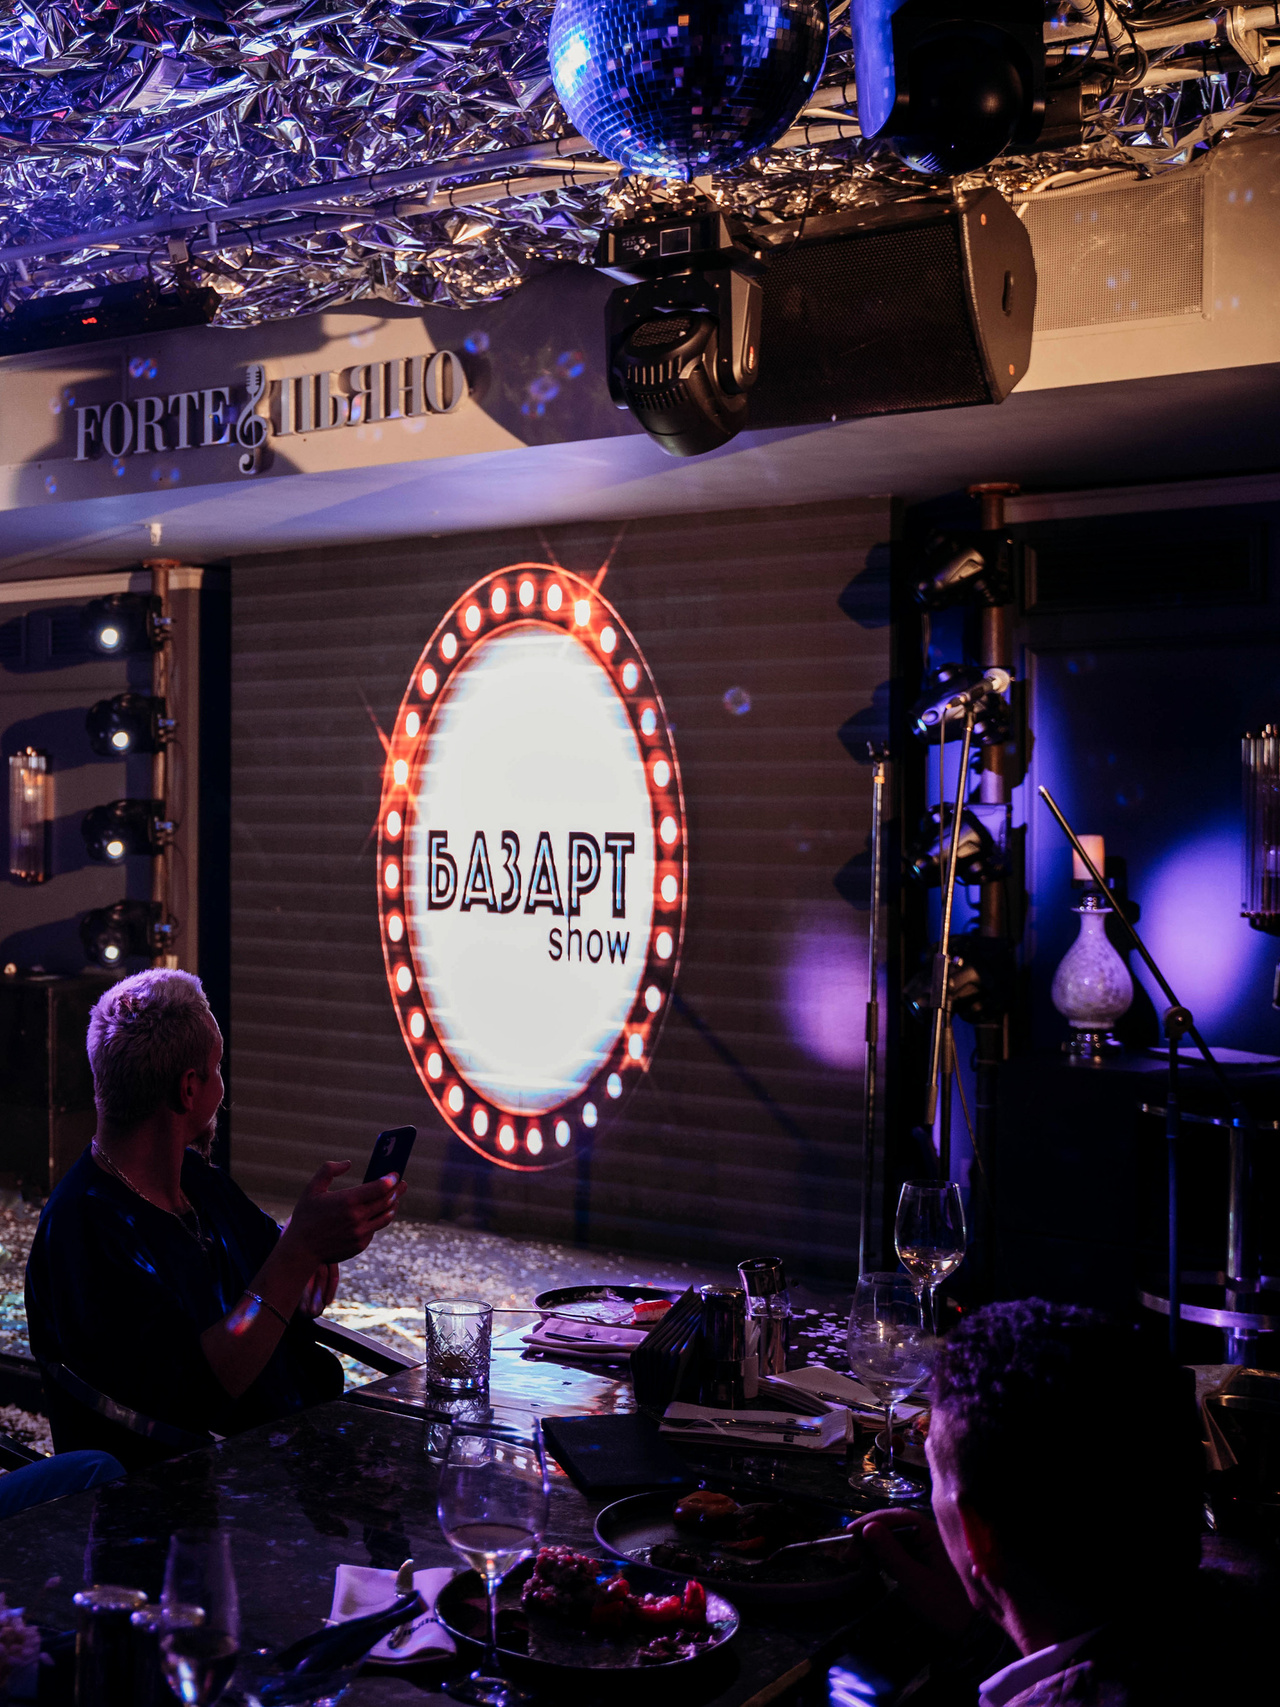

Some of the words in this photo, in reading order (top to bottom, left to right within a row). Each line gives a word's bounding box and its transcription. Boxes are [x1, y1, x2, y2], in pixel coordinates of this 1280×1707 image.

[73, 386, 231, 461] FORTE
[270, 350, 464, 436] ПЬЯНО
[427, 830, 635, 919] БАЗАРТ
[548, 917, 630, 964] show
